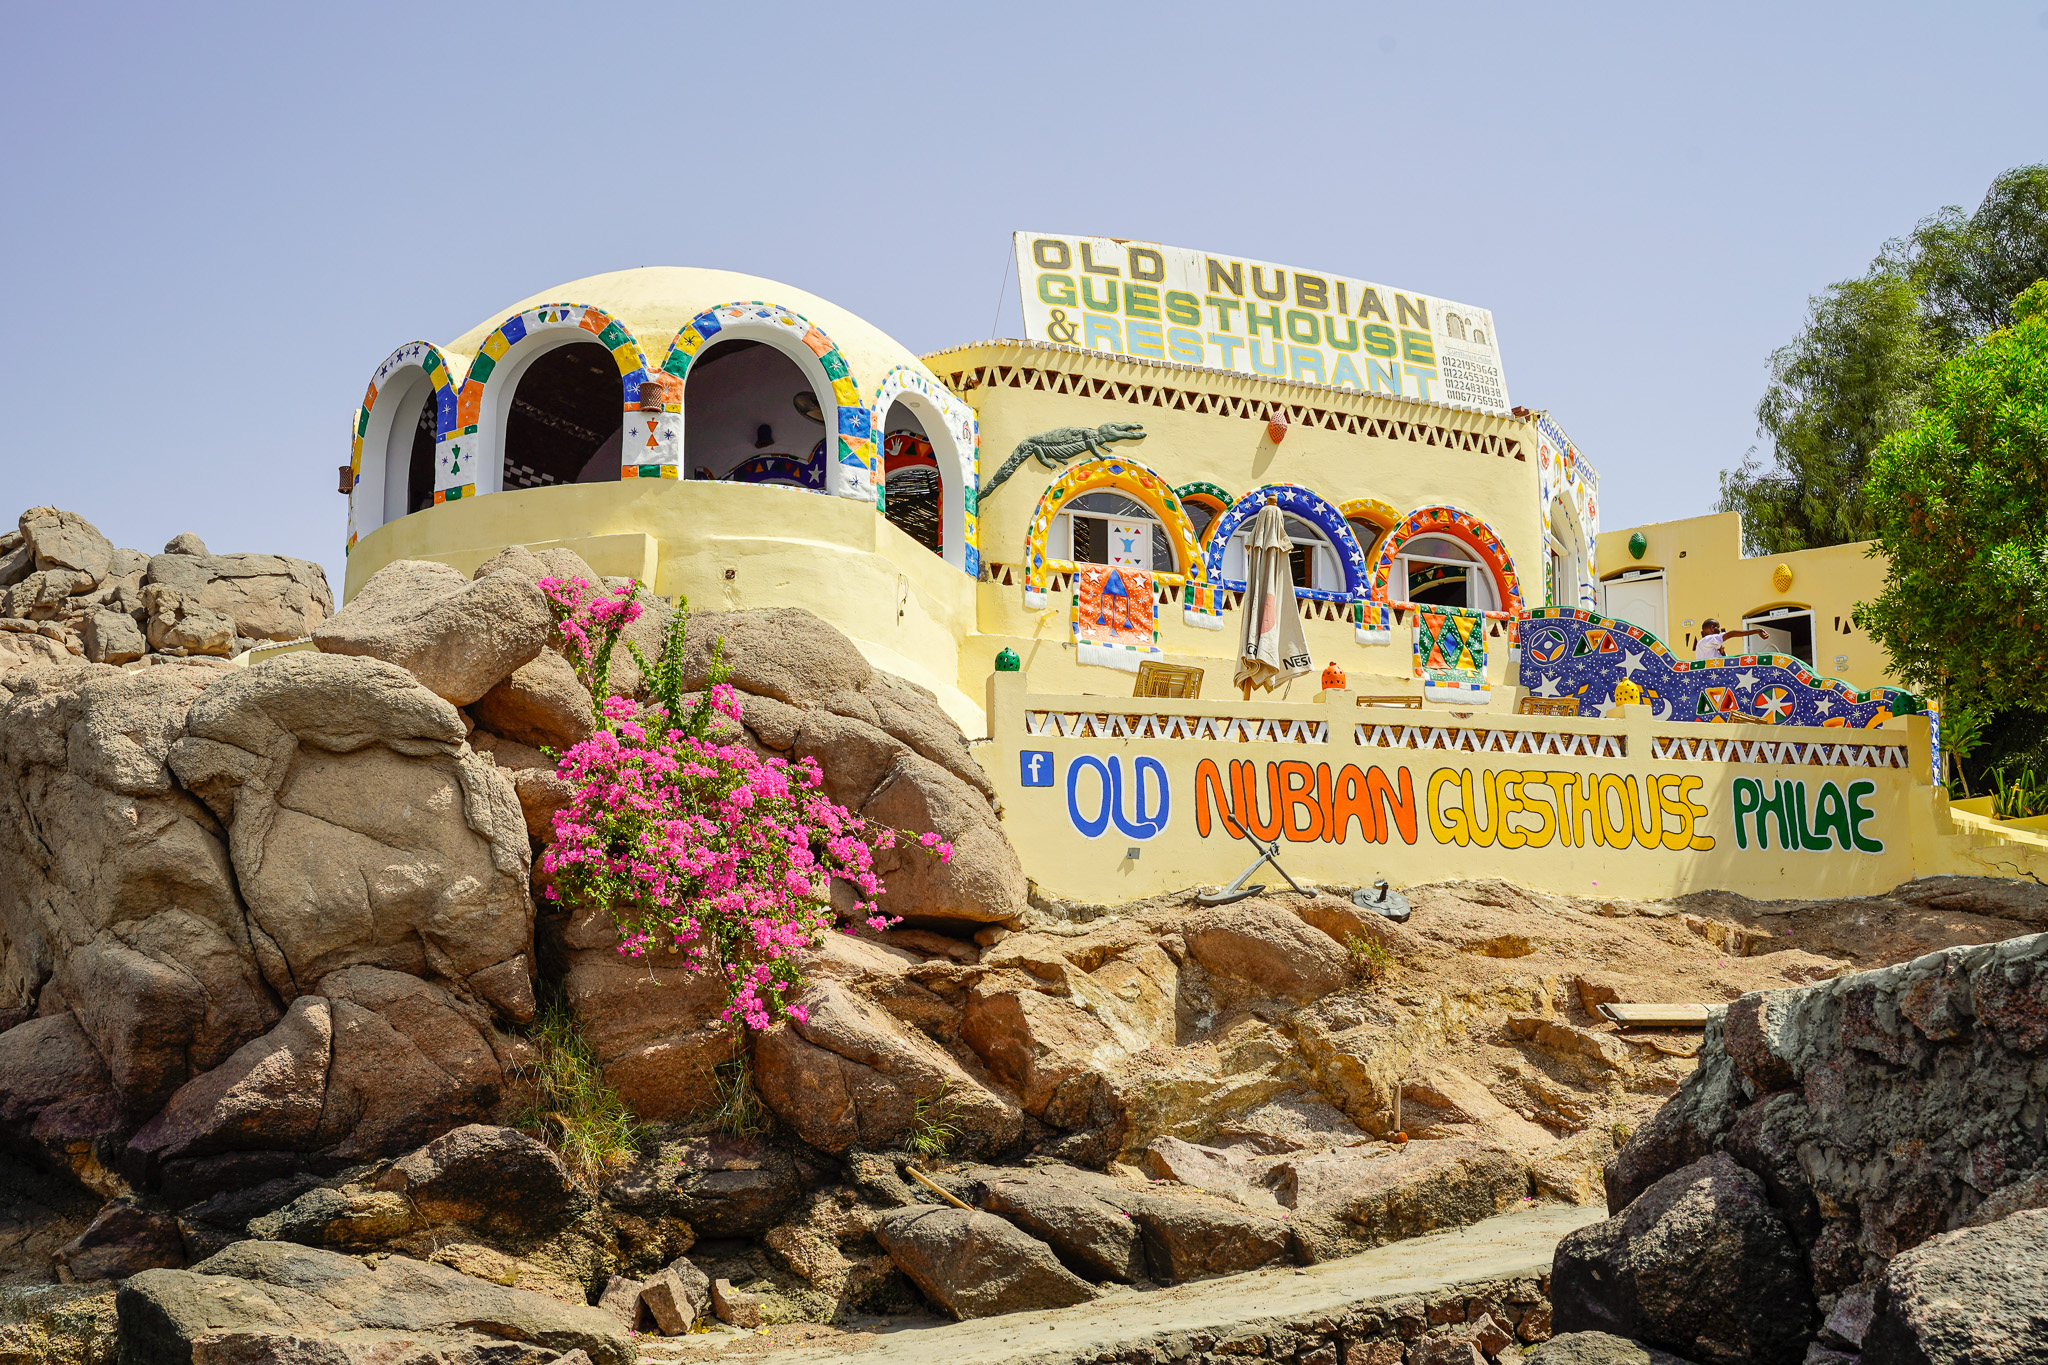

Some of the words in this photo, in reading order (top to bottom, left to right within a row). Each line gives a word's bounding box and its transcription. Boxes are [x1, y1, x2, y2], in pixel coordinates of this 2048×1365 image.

[1032, 238, 1166, 284] OLD
[1206, 257, 1431, 331] NUBIAN
[1036, 272, 1436, 367] GUESTHOUSE
[1046, 308, 1081, 347] &
[1083, 312, 1438, 401] RESTURANT
[1065, 753, 1170, 840] OLD
[1194, 758, 1418, 845] NUBIAN
[1427, 767, 1716, 851] GUESTHOUSE
[1732, 776, 1885, 855] PHILAE
